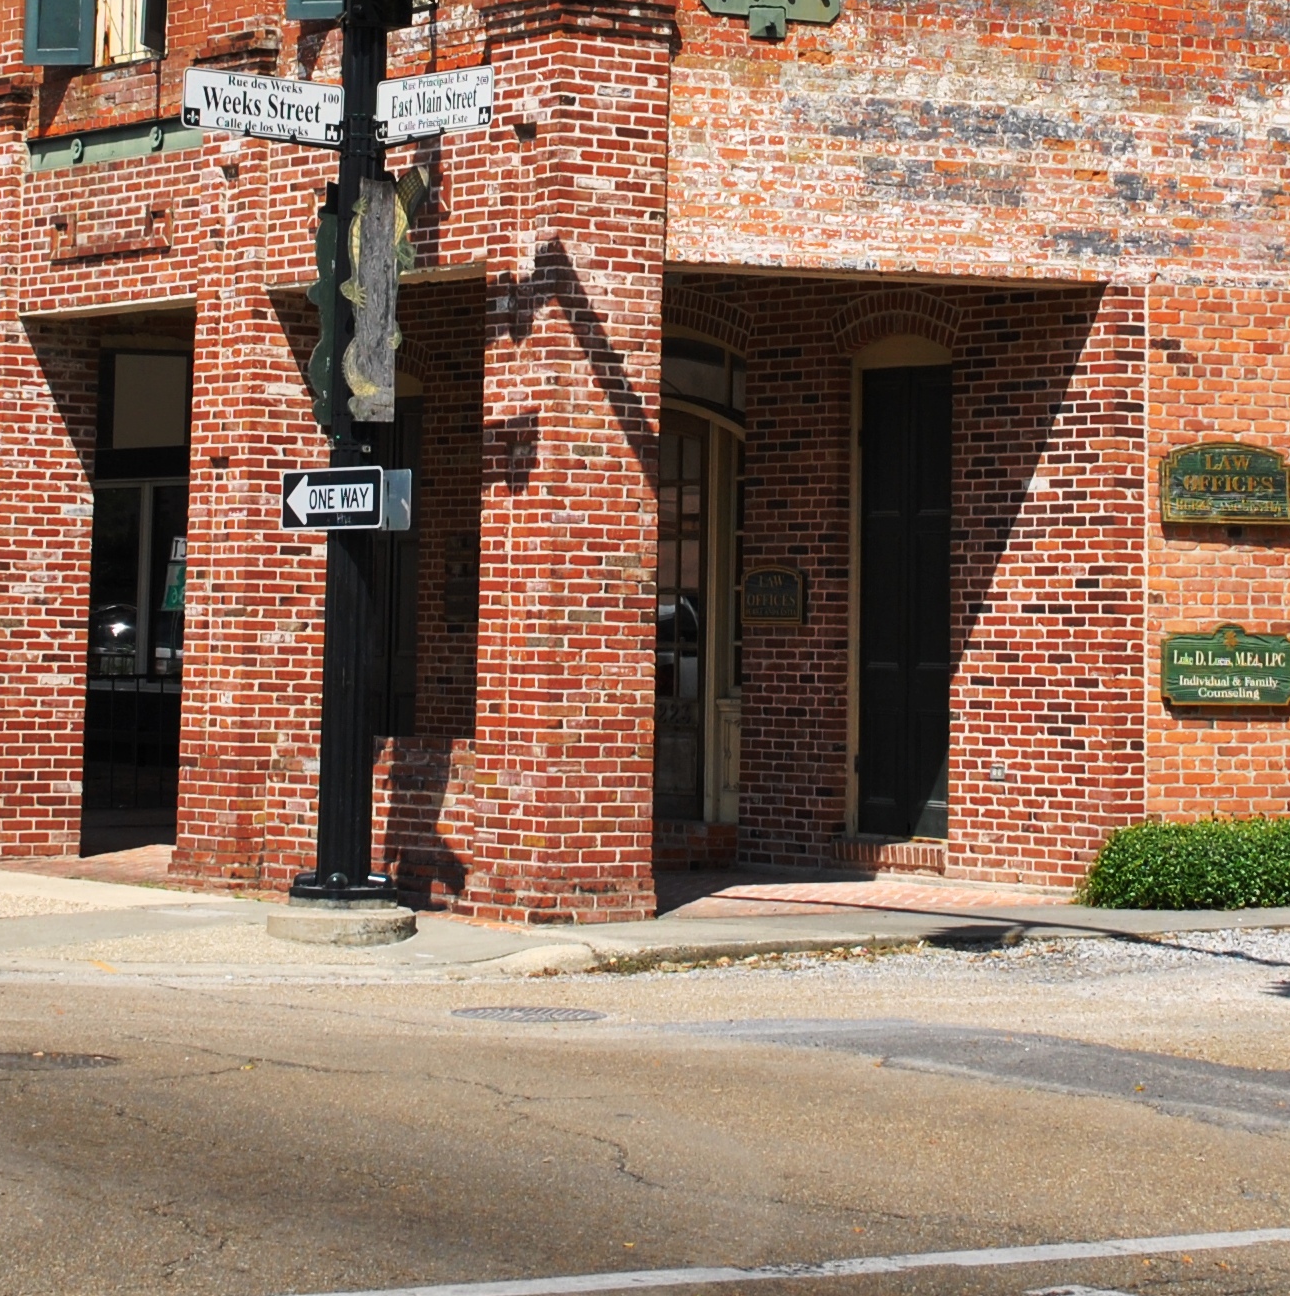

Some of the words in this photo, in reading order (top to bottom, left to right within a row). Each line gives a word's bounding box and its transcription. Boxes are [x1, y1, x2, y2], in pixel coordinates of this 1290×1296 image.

[228, 75, 249, 88] Rue
[251, 78, 267, 90] des
[270, 80, 303, 94] Weeks
[402, 81, 416, 91] Rue
[418, 75, 454, 89] Principale
[456, 73, 468, 83] Est
[202, 85, 262, 117] Weeks
[267, 93, 322, 124] Street
[322, 92, 340, 105] 100
[391, 95, 413, 120] East
[415, 89, 442, 116] Main
[444, 85, 477, 111] Street
[216, 116, 242, 130] Calle
[245, 120, 257, 132] de
[260, 122, 274, 133] los
[277, 123, 309, 137] Weeks
[398, 121, 416, 132] Calle
[418, 115, 450, 129] Principal
[452, 113, 468, 124] Este
[1204, 453, 1252, 471] LAW
[1183, 474, 1274, 493] OFFICES
[309, 488, 335, 510] ONE
[340, 486, 369, 509] WAY
[759, 575, 785, 588] LAW
[746, 593, 796, 607] OFFICES
[1195, 650, 1207, 666] D.
[1265, 652, 1286, 667] LPC
[1179, 674, 1229, 686] Individual
[1232, 677, 1241, 687] &
[1244, 676, 1279, 689] Family
[1197, 687, 1260, 700] Counseling
